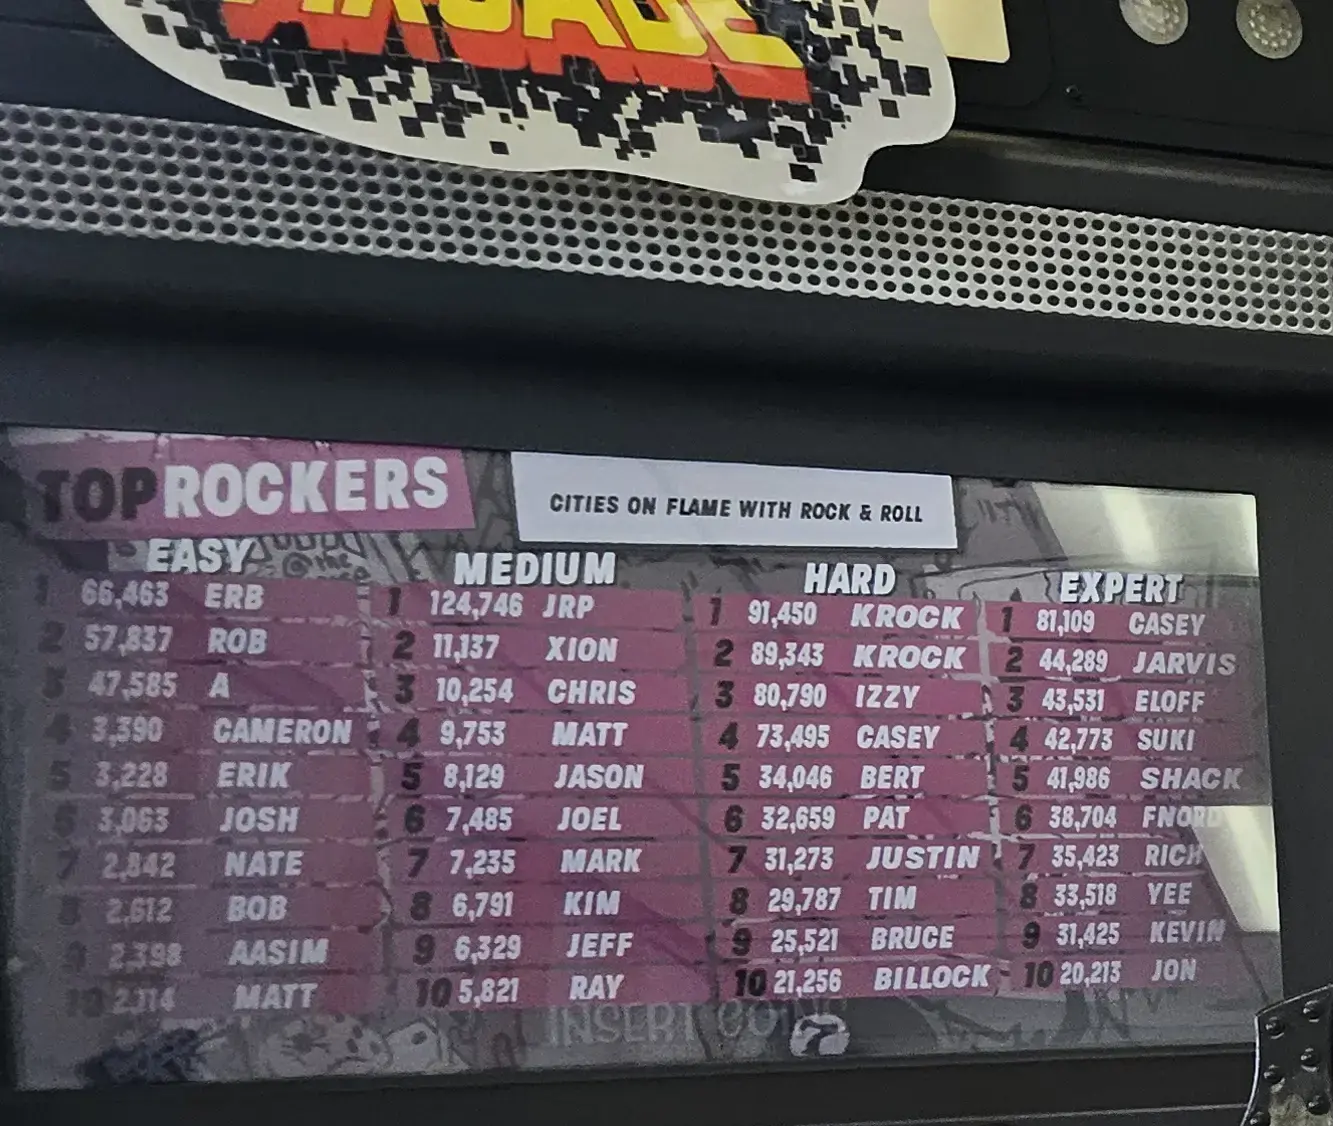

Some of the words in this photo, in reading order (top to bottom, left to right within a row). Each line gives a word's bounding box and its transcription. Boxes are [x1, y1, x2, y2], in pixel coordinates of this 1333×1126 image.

[39, 466, 160, 523] TOP
[163, 456, 449, 519] ROCKERS
[549, 493, 619, 514] CITIES
[628, 496, 656, 515] ON
[665, 498, 732, 518] FLAME
[739, 500, 791, 519] WITH
[800, 502, 852, 521] ROCK
[859, 504, 872, 522] &
[880, 504, 923, 522] ROLL
[147, 538, 256, 573] EASY
[454, 553, 616, 585] MEDIUM
[804, 563, 896, 595] HARD
[1059, 572, 1183, 603] EXPERT
[81, 578, 168, 610] 66,463
[204, 584, 264, 610] ERB
[430, 589, 523, 620] 124,746
[542, 595, 594, 618] JRP
[747, 601, 817, 628] 91,450
[850, 604, 964, 629] KROCK
[1036, 608, 1095, 635] 81,109
[1128, 612, 1205, 636] CASEY
[84, 625, 172, 655] 57,837
[208, 628, 267, 654] ROB
[433, 634, 500, 662] 11,137
[546, 637, 618, 660] XION
[751, 642, 824, 668] 89,343
[853, 646, 967, 670] KROCK
[1038, 648, 1108, 674] 44,289
[1132, 652, 1236, 675] JARVIS
[89, 671, 178, 700] 47,585
[209, 673, 230, 699] A
[436, 678, 514, 705] 10,254
[547, 680, 636, 704] CHRIS
[753, 683, 827, 708] 80,790
[856, 685, 920, 708] IZZY
[1041, 688, 1104, 714] 43,531
[1135, 690, 1205, 713] ELOFF
[212, 719, 352, 744] CAMERON
[440, 720, 505, 748] 9,753
[551, 723, 628, 746] MATT
[756, 724, 830, 750] 73,495
[857, 725, 940, 749] CASEY
[1044, 727, 1113, 753] 42,773
[1136, 728, 1195, 750] SUKI
[95, 761, 168, 789] 3,228
[217, 763, 290, 789] ERIK
[443, 764, 504, 791] 8,129
[554, 765, 644, 789] JASON
[759, 765, 832, 790] 34,046
[860, 766, 924, 789] BERT
[1047, 766, 1110, 791] 41,986
[1140, 767, 1242, 790] SHACK
[220, 807, 299, 832] JOSH
[446, 807, 512, 834] 7,485
[557, 808, 622, 831] JOEL
[761, 805, 835, 831] 32,659
[863, 806, 910, 829] PAT
[1049, 805, 1117, 830] 38,704
[225, 851, 303, 876] NATE
[449, 849, 516, 877] 7,235
[560, 849, 640, 873] MARK
[764, 845, 834, 872] 31,273
[865, 846, 980, 869] JUSTIN
[1051, 843, 1120, 868] 35,423
[1144, 843, 1202, 866] RICH
[227, 896, 288, 920] BOB
[452, 892, 514, 919] 6,791
[564, 891, 621, 916] KIM
[768, 887, 841, 913] 29,787
[869, 886, 917, 909] TIM
[1053, 882, 1116, 907] 33,518
[1147, 882, 1191, 904] YEE
[771, 928, 838, 953] 25,521
[871, 926, 954, 950] BRUCE
[1056, 920, 1120, 946] 31,425
[1150, 918, 1226, 943] KEVIN
[229, 939, 328, 965] AASIM
[454, 934, 521, 962] 6,329
[566, 933, 633, 958] JEFF
[773, 969, 842, 995] 21,256
[875, 964, 990, 990] BILLOCK
[1060, 960, 1120, 985] 20,213
[1151, 958, 1196, 981] JON
[234, 983, 317, 1010] MATT
[458, 977, 518, 1005] 5,821
[569, 974, 624, 1000] RAY
